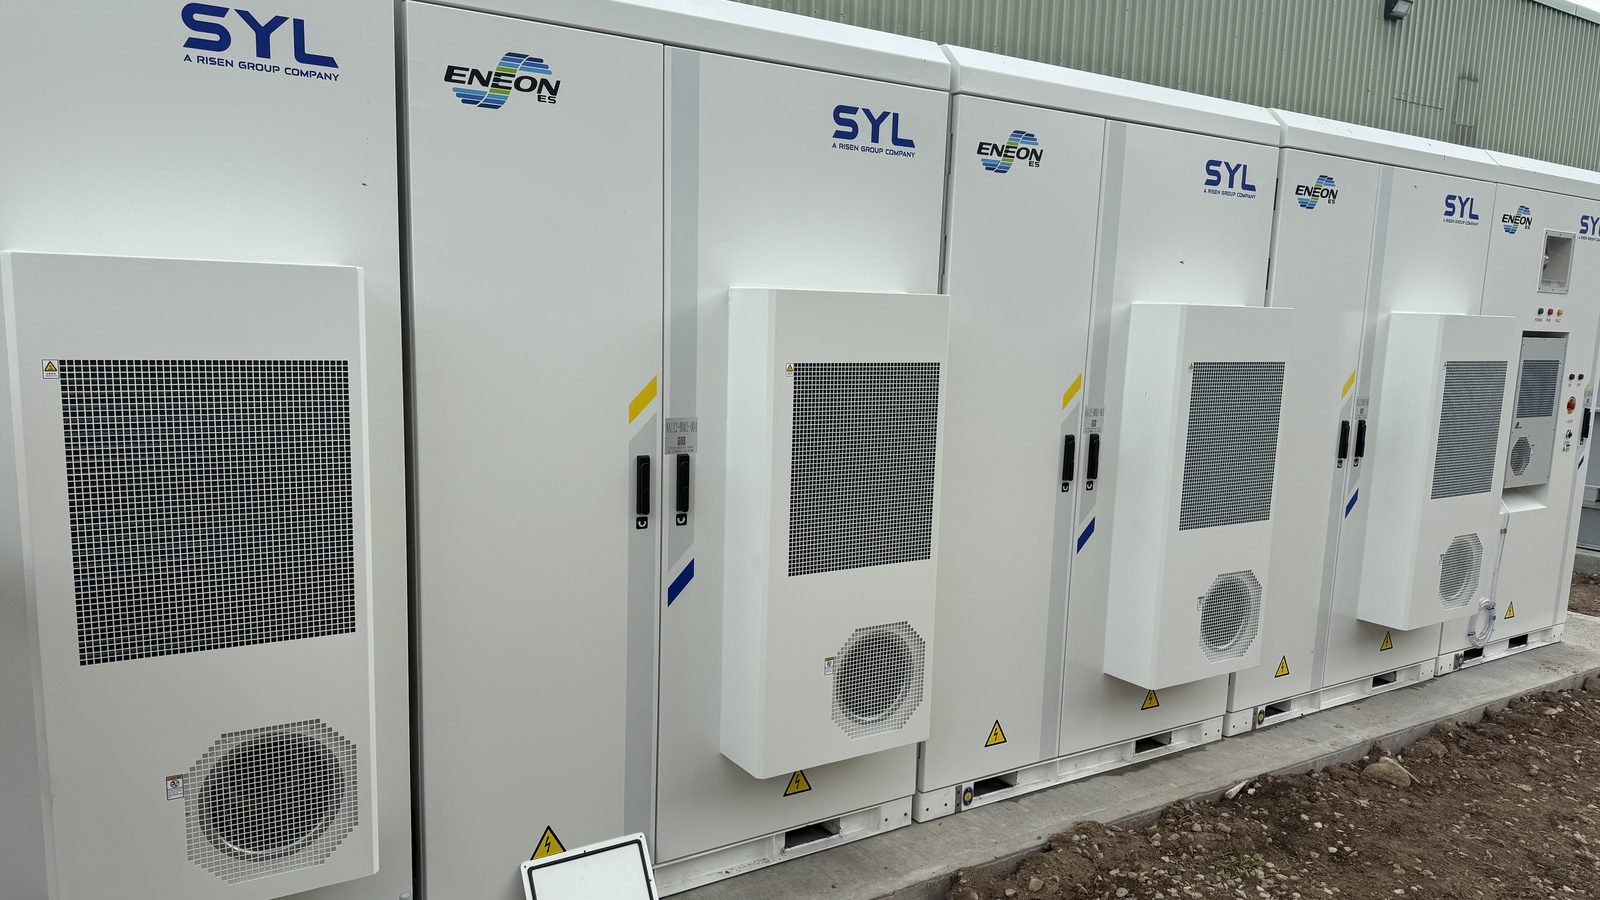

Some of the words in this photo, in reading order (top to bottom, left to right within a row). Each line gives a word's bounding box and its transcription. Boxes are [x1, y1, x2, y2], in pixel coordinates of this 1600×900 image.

[181, 2, 339, 69] SYL
[183, 53, 193, 63] A
[196, 55, 234, 68] RISEN
[238, 60, 280, 74] GROUP
[284, 67, 340, 82] COMPANY
[444, 65, 561, 96] ENEON
[537, 94, 557, 104] ES
[832, 104, 916, 149] SYL
[838, 143, 859, 151] RISEN
[860, 145, 884, 154] GROUP
[885, 148, 916, 158] COMPANY
[976, 141, 1044, 162] ENEON
[1028, 160, 1041, 168] ES
[1204, 159, 1257, 192] SYL
[1295, 184, 1339, 200] ENEON
[1443, 194, 1480, 220] SYL
[1501, 213, 1533, 226] ENEON
[1579, 214, 1600, 237] SY
